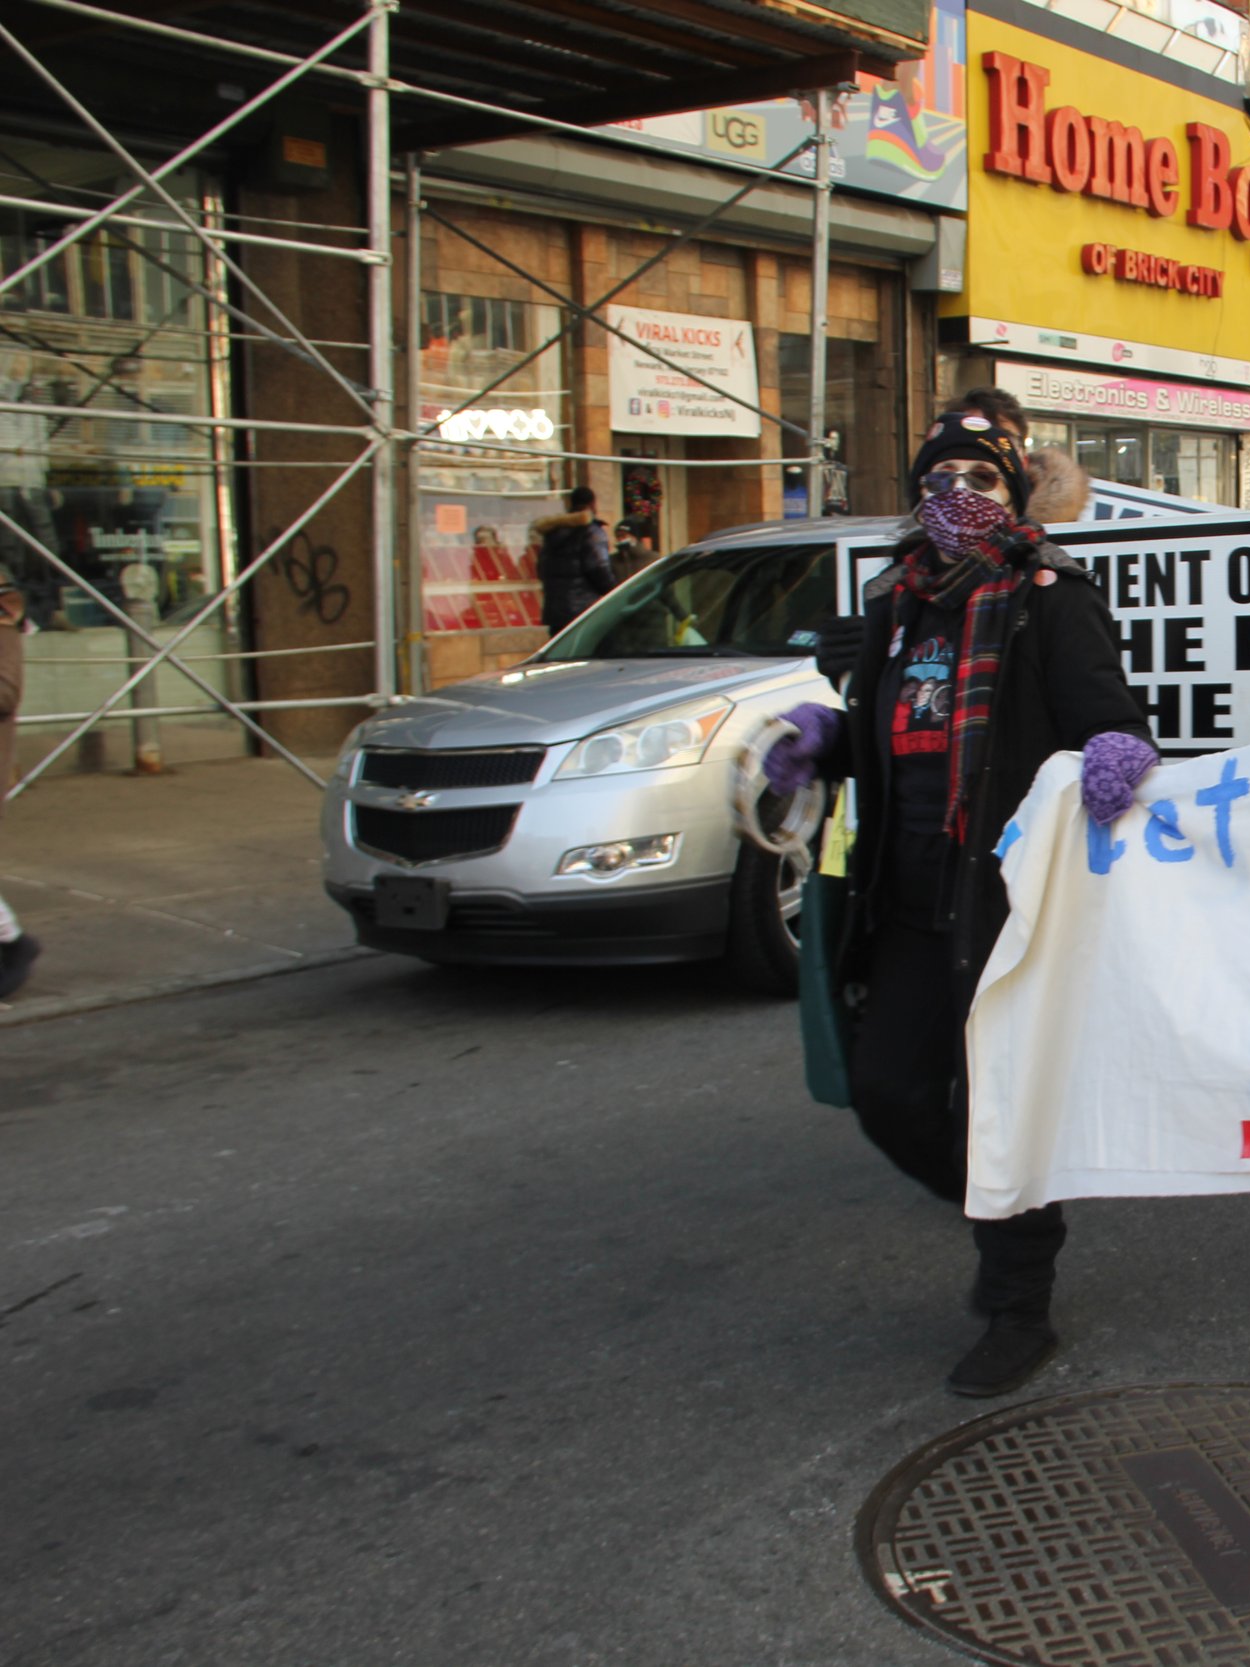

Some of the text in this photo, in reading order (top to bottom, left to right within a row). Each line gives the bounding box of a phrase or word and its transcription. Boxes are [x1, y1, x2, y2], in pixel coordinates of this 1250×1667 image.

[712, 112, 759, 149] UGG
[982, 51, 1180, 217] Home
[1082, 242, 1225, 299] OF BRICK CITY
[635, 321, 721, 347] VIRAL KICKS
[1026, 370, 1148, 409] Electronics
[1154, 387, 1171, 411] &
